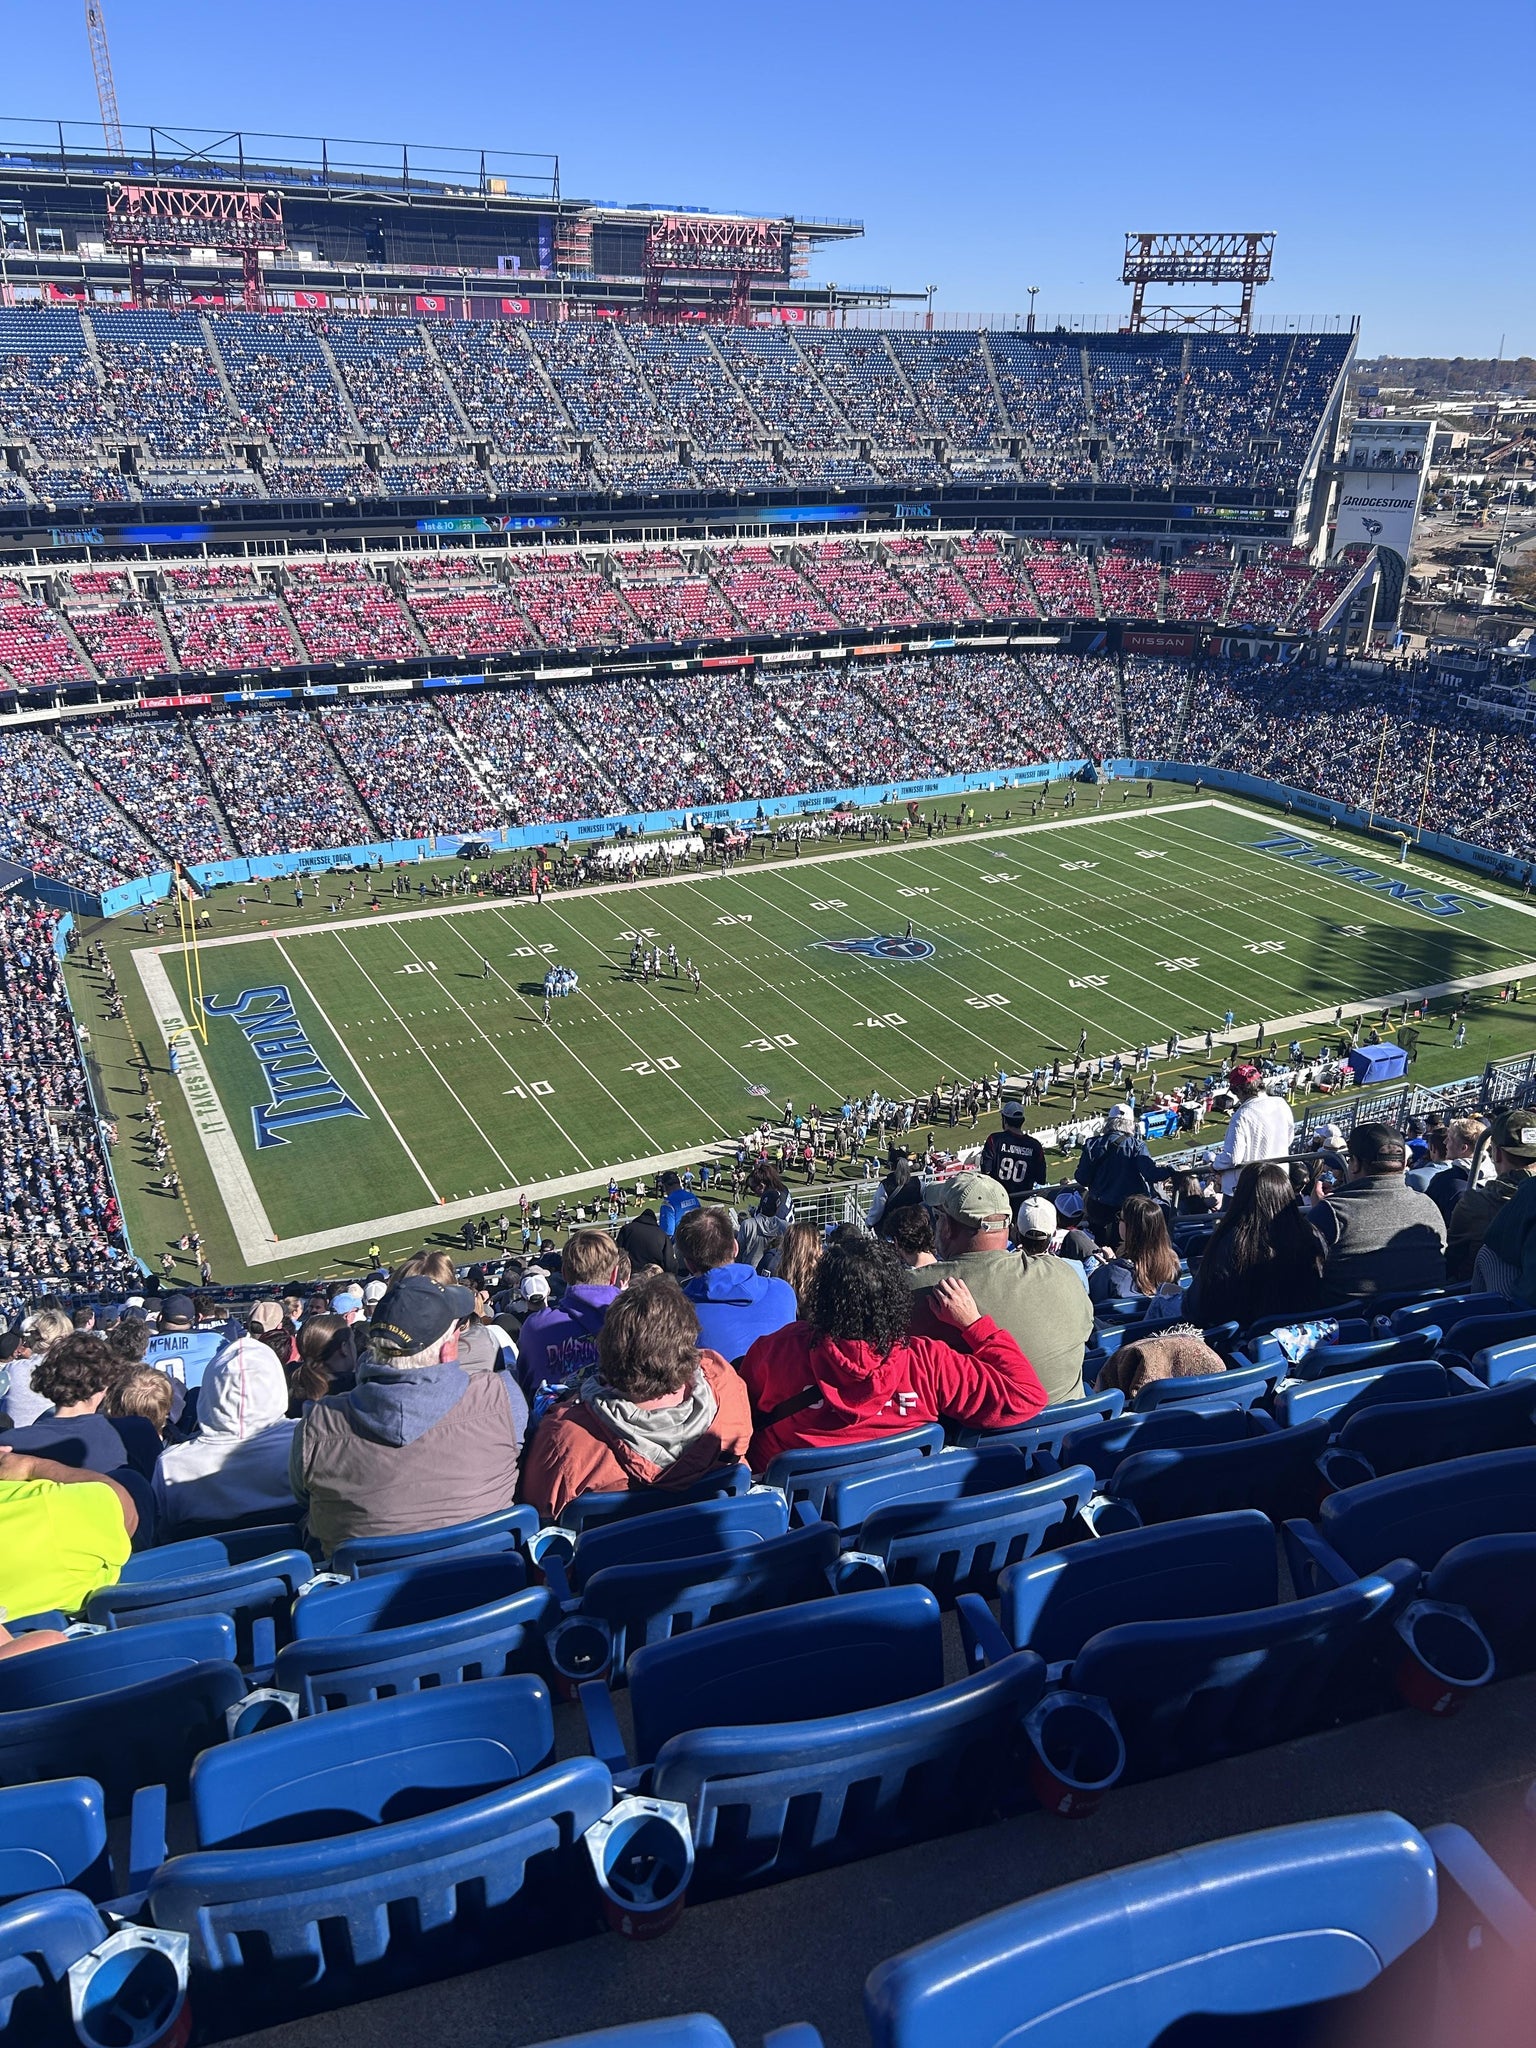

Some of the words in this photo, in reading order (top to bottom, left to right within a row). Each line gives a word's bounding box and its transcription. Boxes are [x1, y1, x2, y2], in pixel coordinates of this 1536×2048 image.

[1342, 496, 1416, 509] BRIDGESTONE
[1131, 636, 1185, 647] NISSAN
[1439, 671, 1463, 688] lite
[211, 704, 231, 712] KEITH
[258, 700, 286, 708] NORTON
[126, 711, 149, 719] ADAMS
[577, 824, 605, 835] TENNESSEE
[298, 855, 331, 867] TENNESSEE
[1315, 835, 1376, 859] SALUTE
[1406, 866, 1483, 894] SERVICE
[979, 873, 1016, 884] 30
[1234, 830, 1493, 917] TITANS
[896, 887, 931, 898] 40
[809, 899, 849, 911] 50
[717, 913, 753, 925] 40
[618, 928, 662, 942] 30
[516, 943, 559, 957] 20
[1242, 940, 1283, 955] 20
[404, 961, 439, 975] 10
[1155, 956, 1196, 972] 30
[1068, 974, 1108, 989] 40
[963, 993, 1012, 1010] 50
[162, 1017, 185, 1031] US
[866, 1013, 908, 1028] 40
[749, 1034, 800, 1052] 30
[194, 984, 370, 1151] TITANS
[630, 1056, 682, 1076] 20
[187, 1075, 218, 1117] TAKES
[513, 1080, 556, 1099] 10
[200, 1121, 226, 1134] IT
[998, 1157, 1028, 1183] 90
[397, 1329, 413, 1343] NAVY
